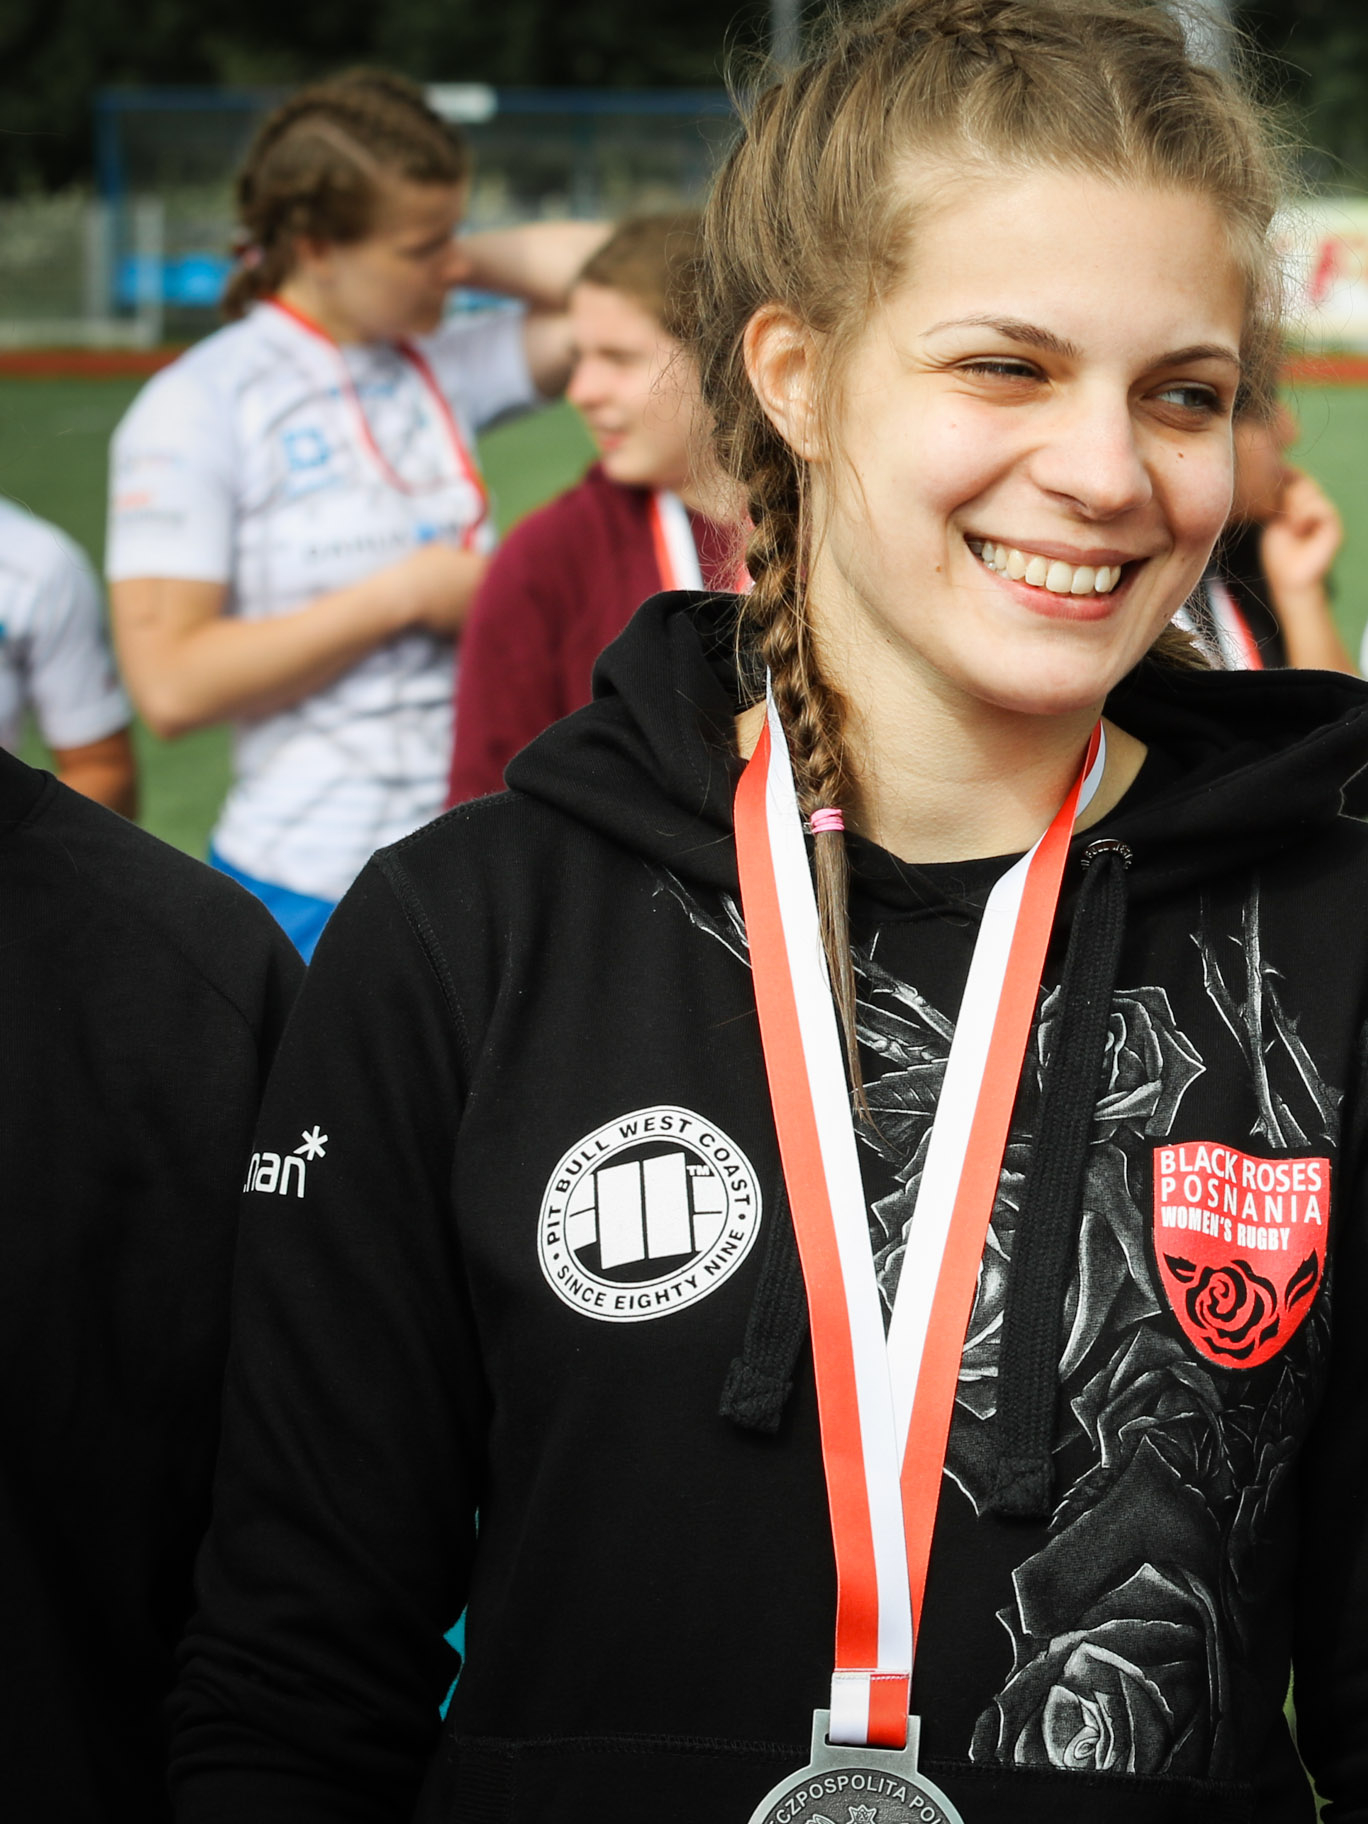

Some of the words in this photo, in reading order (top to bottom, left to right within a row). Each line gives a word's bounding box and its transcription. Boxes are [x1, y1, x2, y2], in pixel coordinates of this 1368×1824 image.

[547, 1205, 561, 1245] PIT
[555, 1139, 610, 1193] BULL
[619, 1115, 692, 1139] WEST
[698, 1132, 750, 1206] COAST
[1160, 1145, 1237, 1184] BLACK
[1242, 1158, 1322, 1192] ROSES
[1160, 1174, 1322, 1225] POSNANIA
[1160, 1206, 1232, 1242] WOMEN'S
[1237, 1224, 1291, 1250] RUGBY
[557, 1264, 606, 1307] SINCE
[614, 1275, 698, 1310] EIGHTY
[704, 1229, 744, 1275] NINE
[769, 1774, 907, 1824] CZPOSPOLITA
